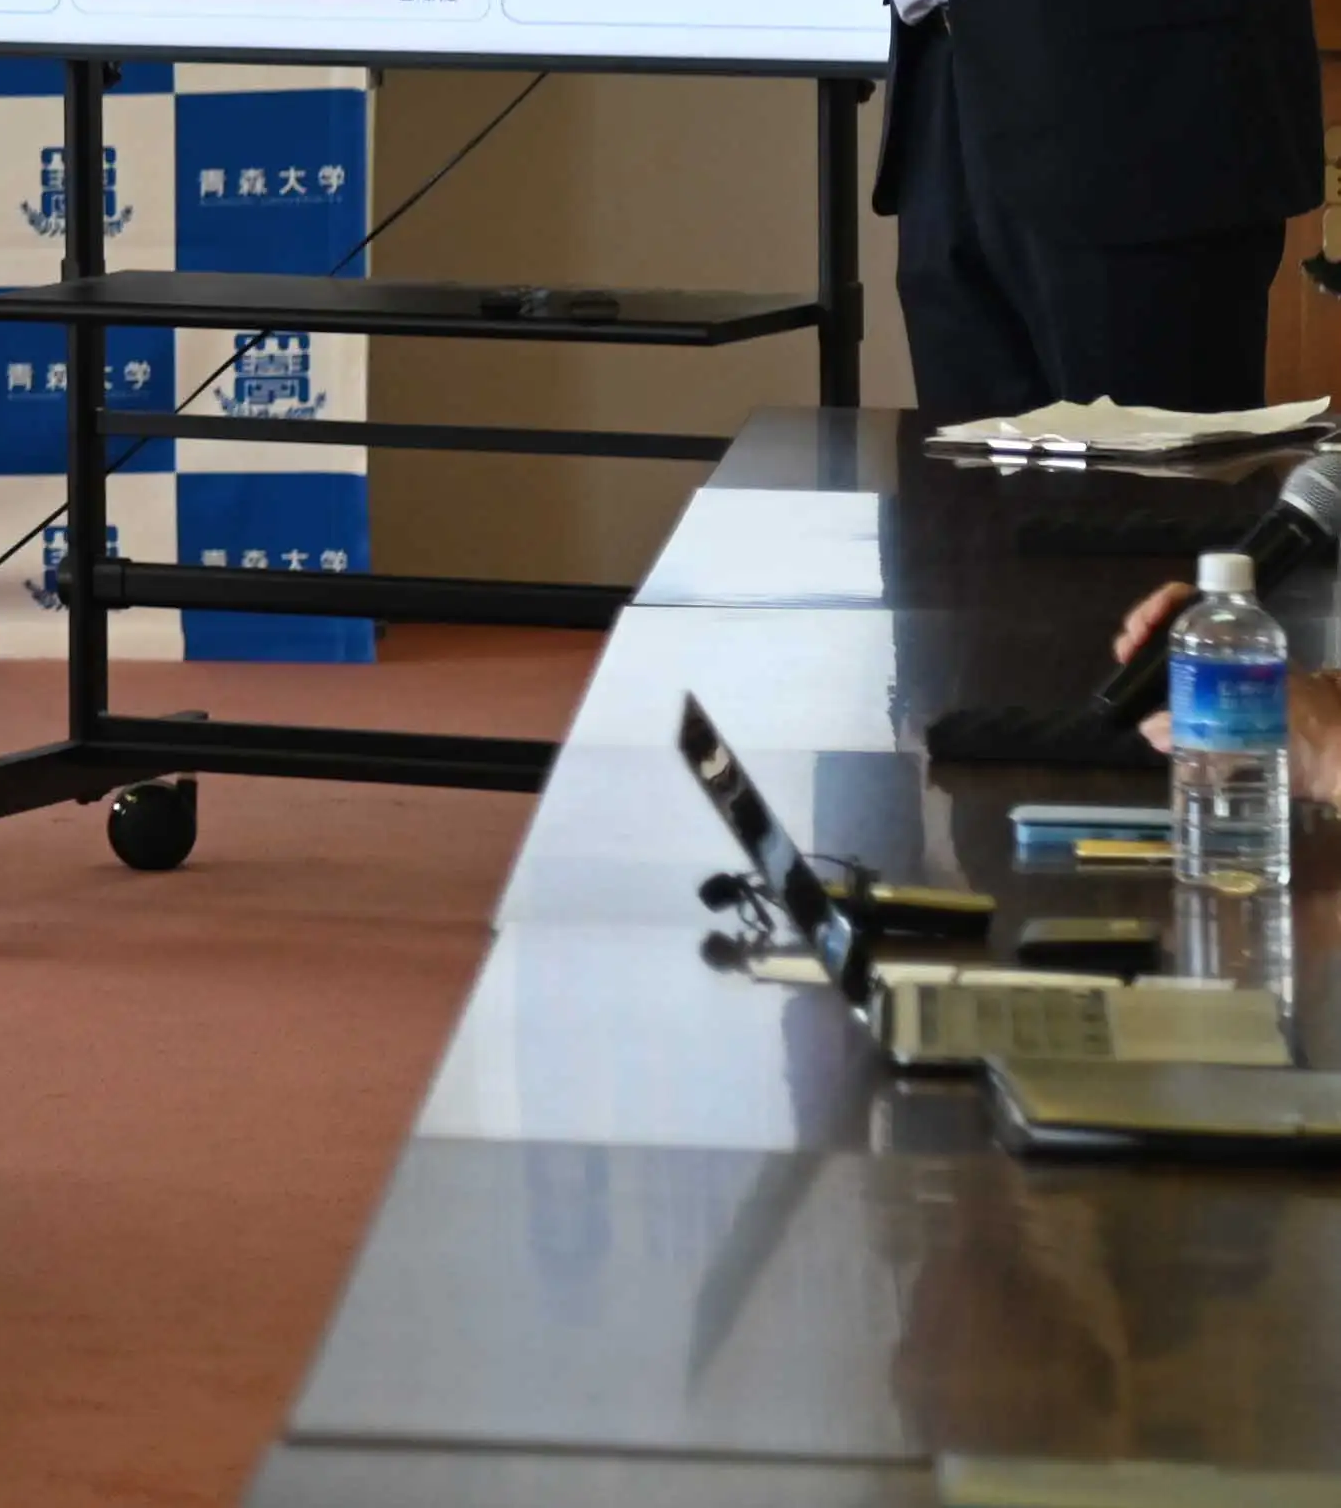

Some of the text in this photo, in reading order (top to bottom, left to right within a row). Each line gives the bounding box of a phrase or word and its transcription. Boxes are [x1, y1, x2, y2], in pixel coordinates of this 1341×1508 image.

[199, 165, 345, 197] 青森大学
[7, 361, 151, 391] 青森学
